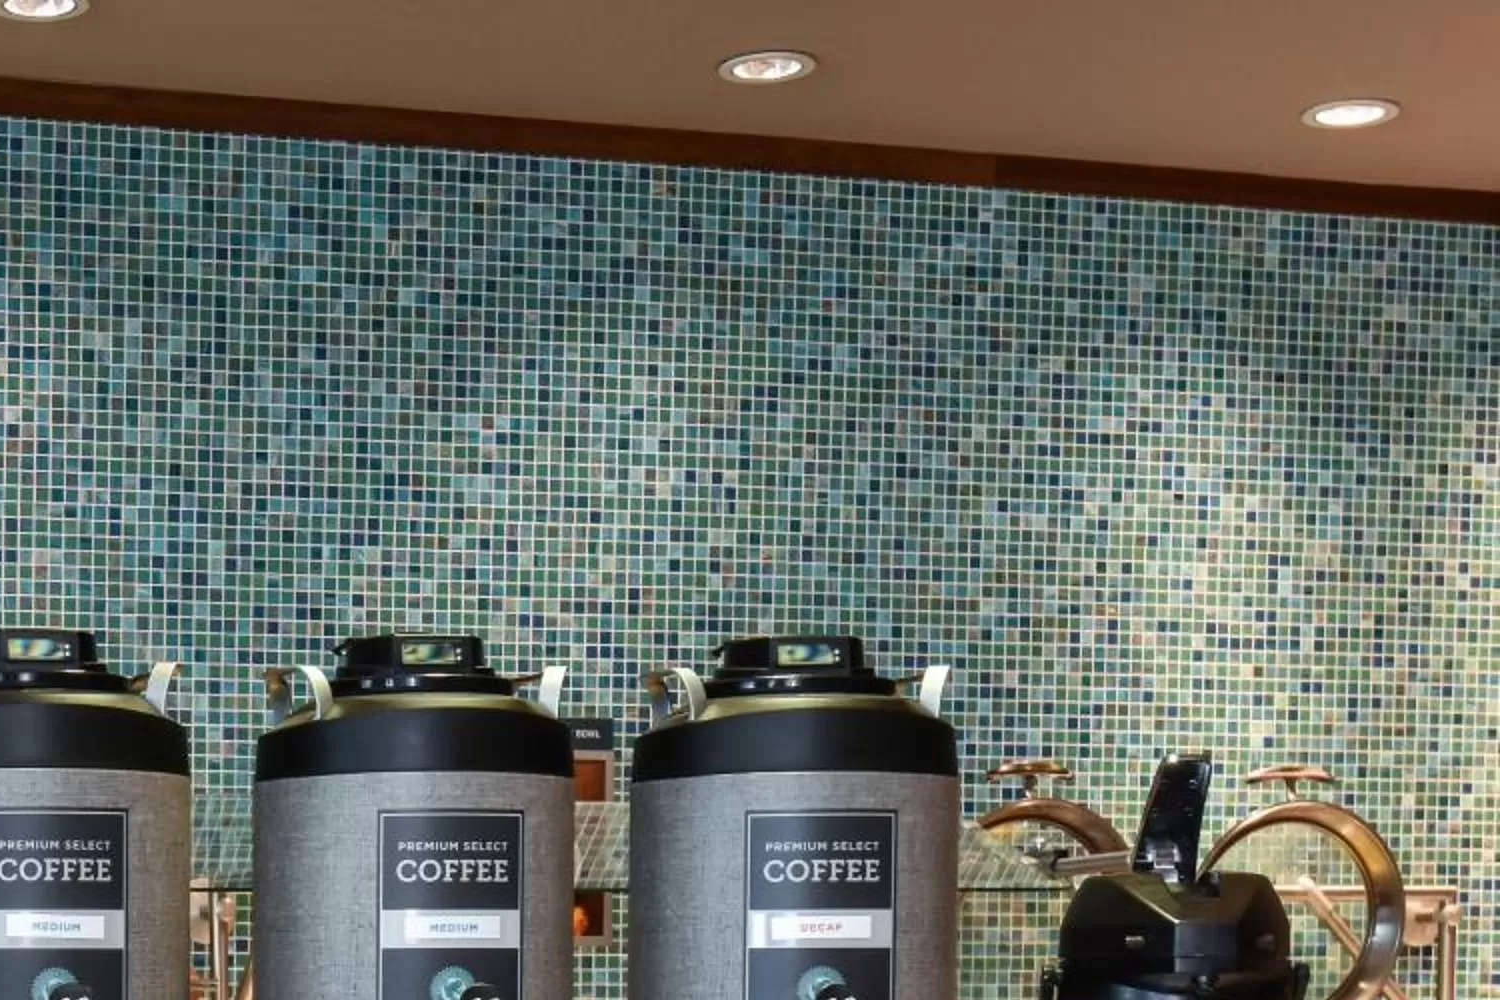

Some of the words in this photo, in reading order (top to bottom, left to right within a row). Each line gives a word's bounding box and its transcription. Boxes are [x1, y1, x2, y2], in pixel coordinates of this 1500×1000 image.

[0, 839, 60, 851] PREMIUM
[64, 839, 111, 851] SELECT
[398, 841, 458, 851] PREMIUM
[463, 841, 508, 851] SELECT
[765, 841, 827, 852] PREMIUM
[832, 841, 879, 852] SELECT
[396, 859, 509, 883] COFFEE
[763, 859, 881, 883] COFFEE
[31, 922, 81, 932] MEDIUM
[429, 923, 479, 933] MEDIUM
